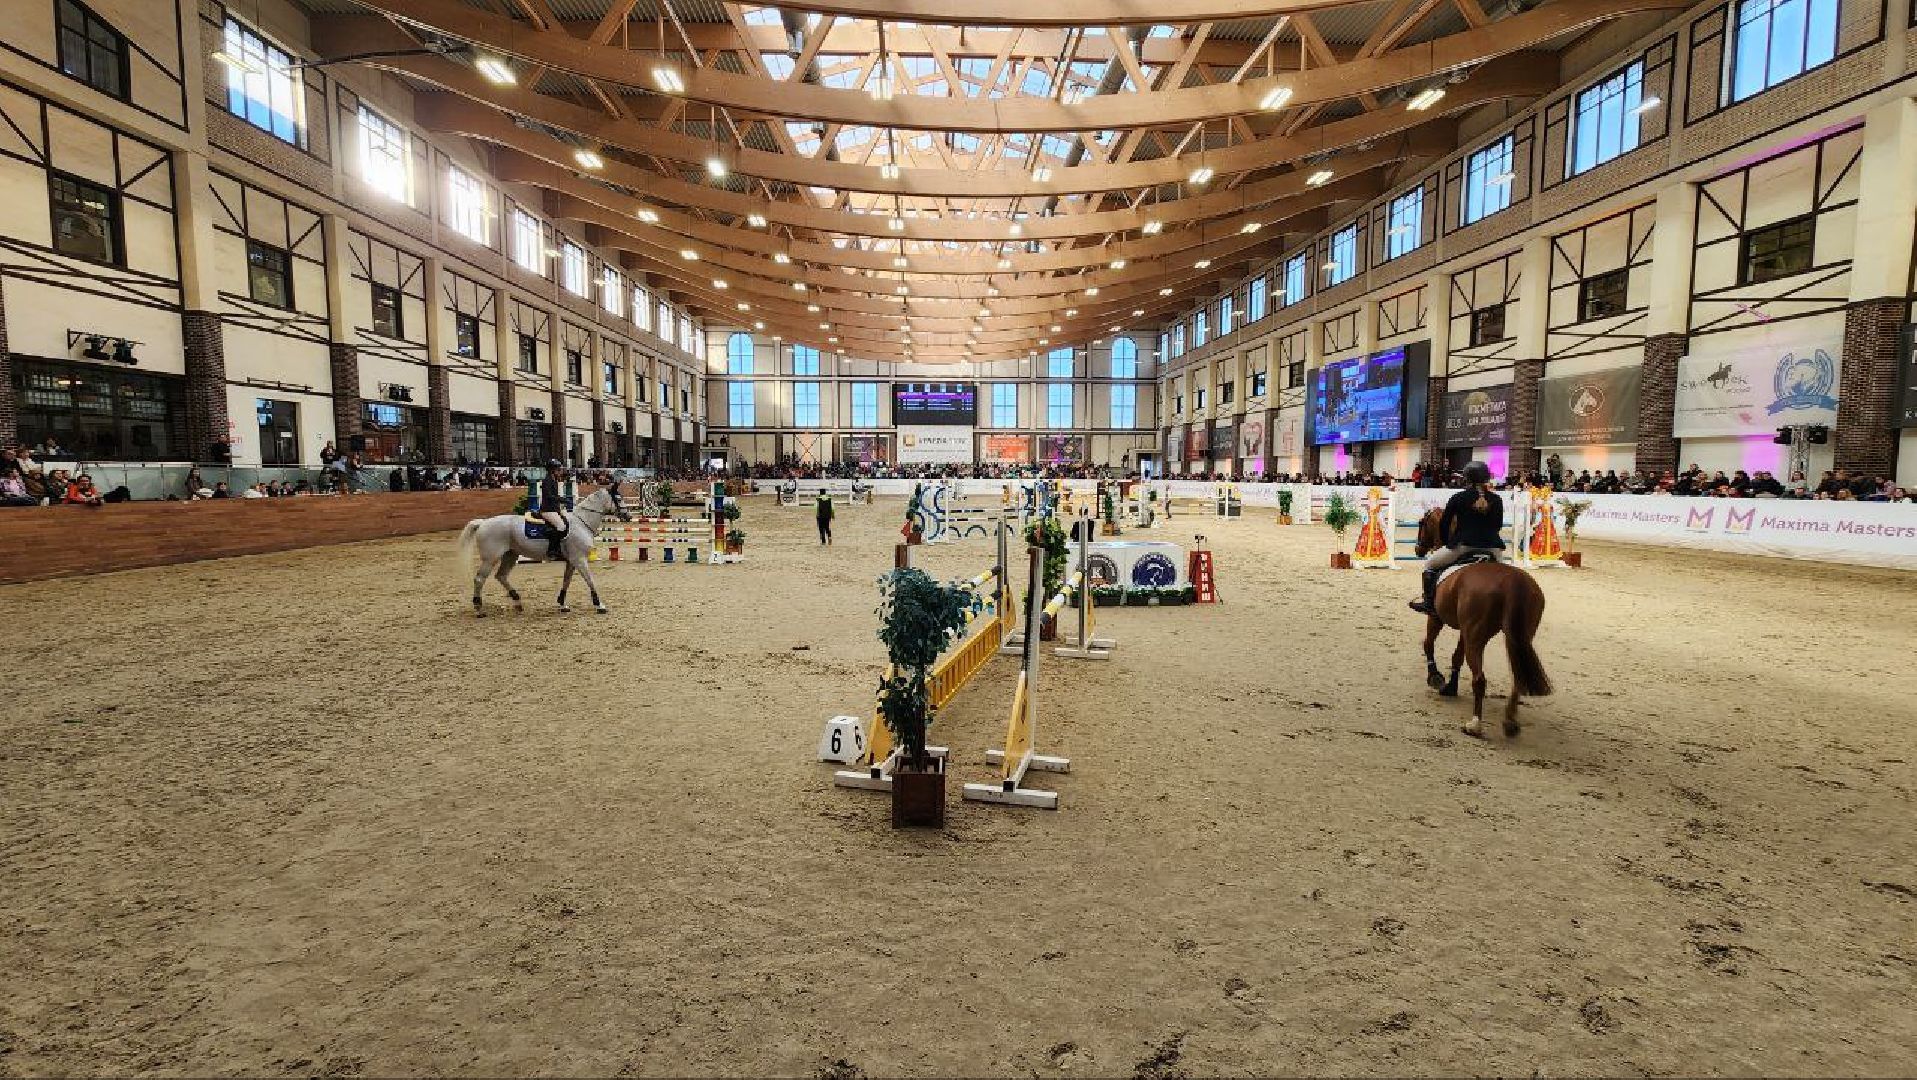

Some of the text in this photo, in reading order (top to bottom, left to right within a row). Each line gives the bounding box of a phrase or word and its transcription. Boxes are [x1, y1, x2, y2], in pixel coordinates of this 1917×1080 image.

[1586, 508, 1680, 523] Maxima Masters
[1760, 516, 1916, 538] Maxima Masters
[831, 728, 842, 754] 6
[854, 725, 863, 750] 6
